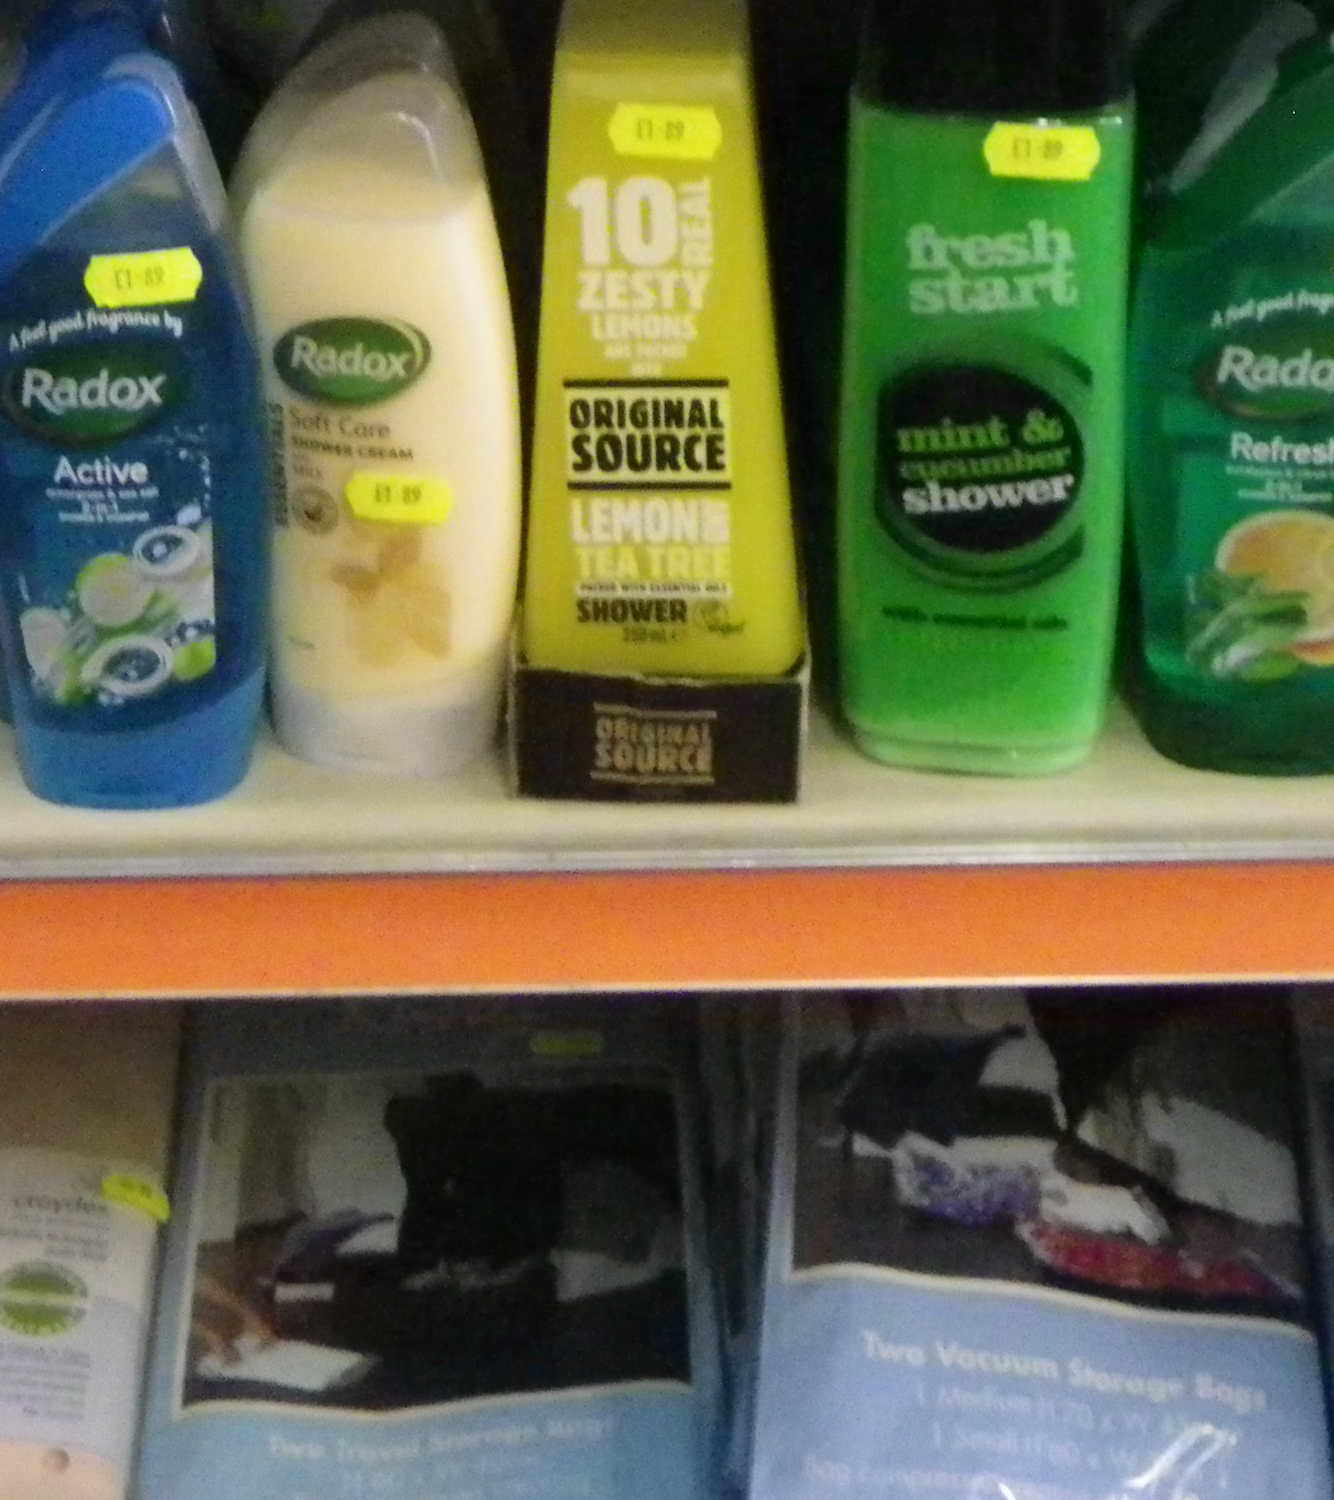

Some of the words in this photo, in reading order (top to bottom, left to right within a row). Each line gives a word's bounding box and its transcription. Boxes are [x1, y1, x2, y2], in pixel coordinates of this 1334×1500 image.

[565, 174, 678, 268] 10
[904, 219, 1075, 272] fresh
[575, 269, 710, 312] ZESTY
[907, 266, 1080, 317] start
[290, 334, 411, 382] Radox
[22, 367, 167, 415] Radox
[568, 397, 726, 431] ORIGINAL
[895, 416, 1010, 454] mint
[1020, 408, 1065, 446] &
[54, 455, 149, 486] Active
[570, 432, 727, 474] SOURCE
[898, 446, 1072, 481] cucumber
[902, 473, 1075, 516] shower
[572, 497, 698, 544] LEMON
[576, 545, 640, 579] TEA
[576, 598, 688, 625] SHOWER
[595, 717, 712, 745] ORIGINAL
[594, 741, 714, 775] SOURCE
[934, 1339, 1059, 1381] Vacuum
[1067, 1355, 1184, 1403] Storage
[1194, 1372, 1267, 1416] Bags
